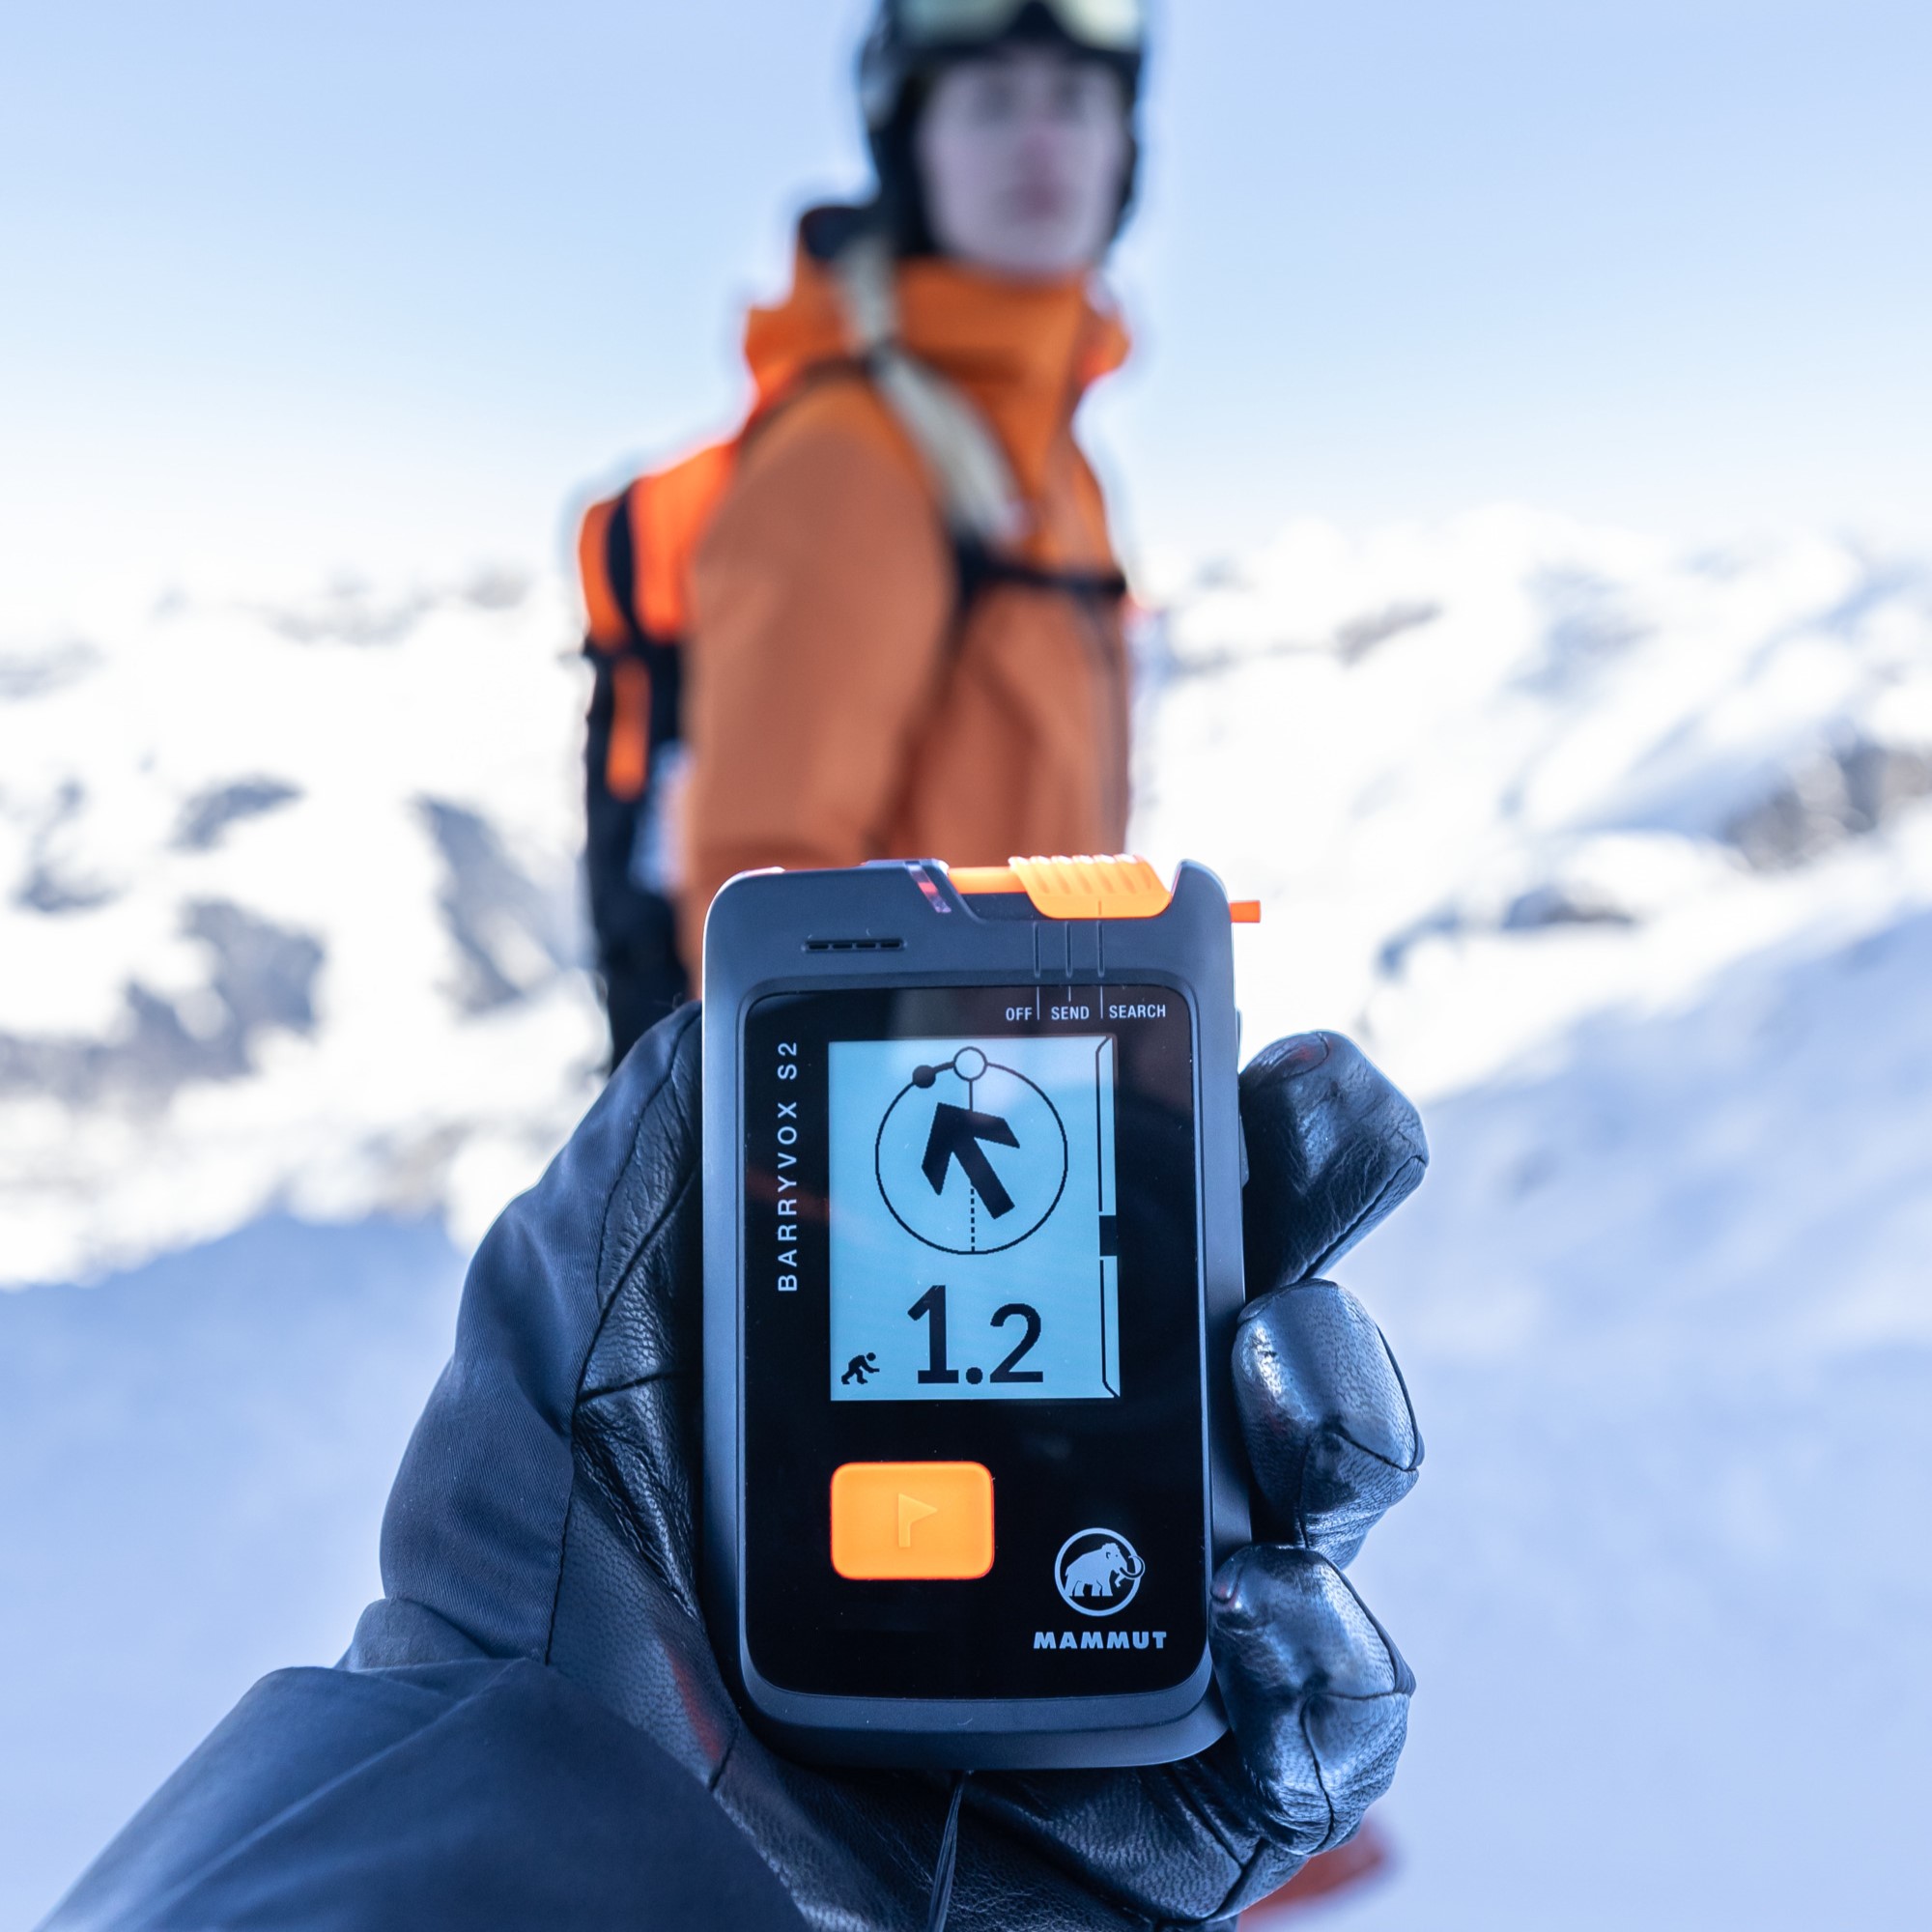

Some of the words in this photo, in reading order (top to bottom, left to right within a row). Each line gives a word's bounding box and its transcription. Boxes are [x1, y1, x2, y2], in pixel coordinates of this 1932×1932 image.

[1006, 1006, 1033, 1021] OFF
[1050, 1005, 1090, 1020] SEND
[1108, 1004, 1166, 1019] SEARCH
[777, 1041, 798, 1080] S2
[777, 1101, 798, 1292] BARRYVOX
[907, 1284, 1044, 1384] 1.2
[1033, 1631, 1167, 1650] MAMMUT
